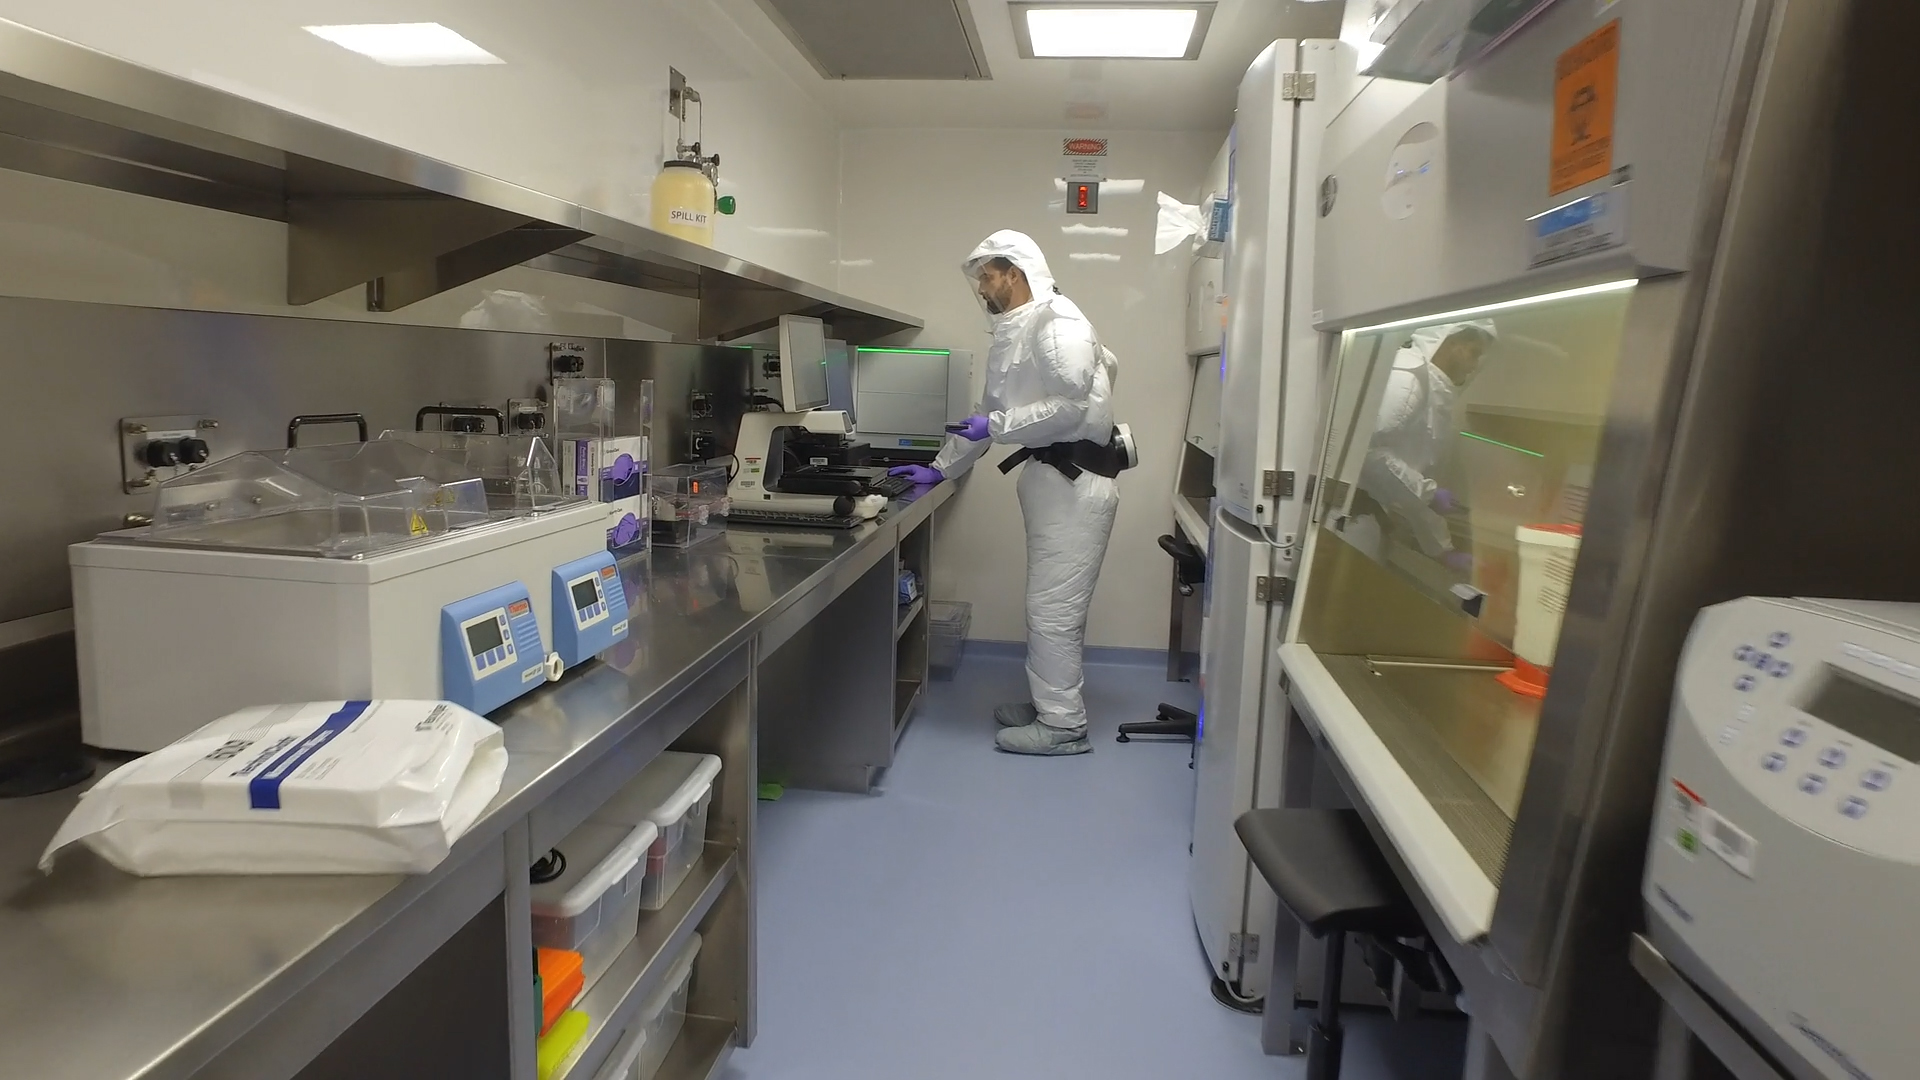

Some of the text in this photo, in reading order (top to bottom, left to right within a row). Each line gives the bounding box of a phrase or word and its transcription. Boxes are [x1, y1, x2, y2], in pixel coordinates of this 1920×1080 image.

[1068, 142, 1101, 151] WARNING
[671, 210, 707, 223] SPILL KIT
